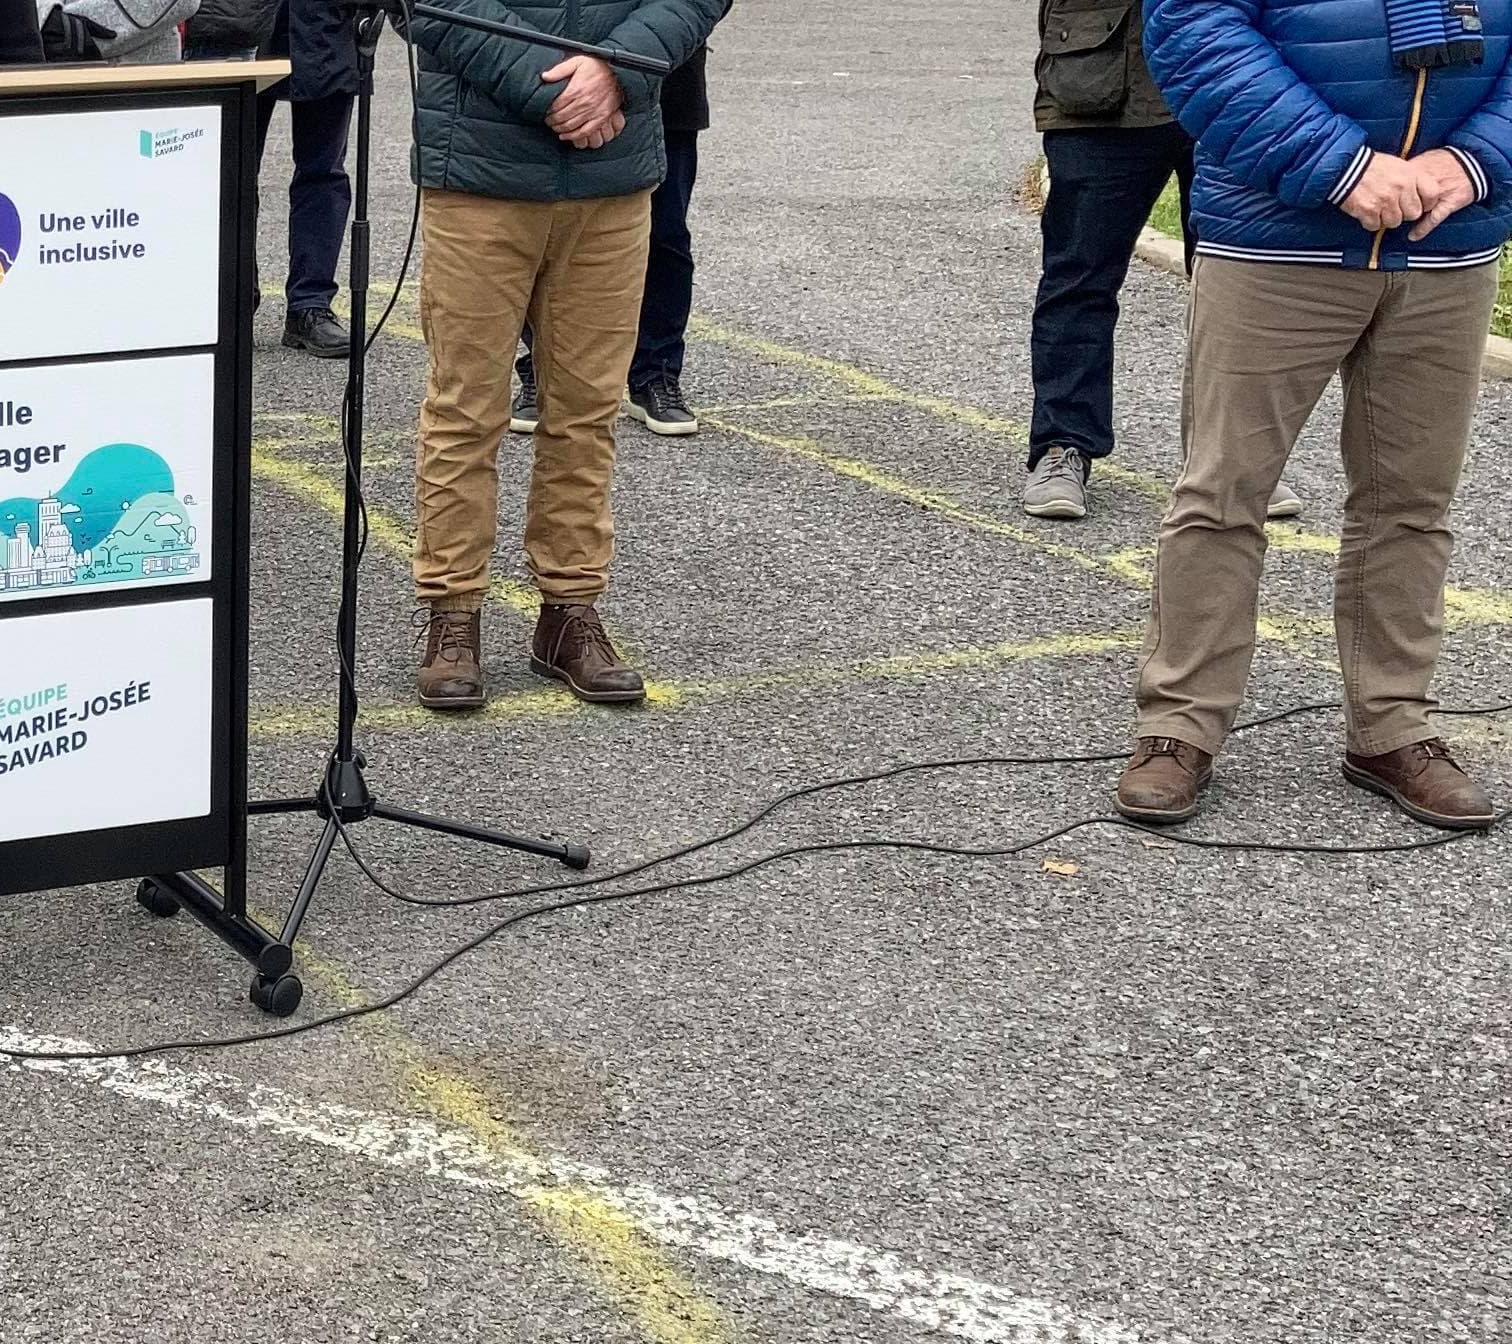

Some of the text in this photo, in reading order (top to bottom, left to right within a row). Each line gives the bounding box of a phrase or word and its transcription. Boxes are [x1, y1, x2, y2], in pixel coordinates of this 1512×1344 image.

[154, 143, 185, 157] SAVARD
[39, 208, 139, 233] Une ville
[39, 239, 145, 264] inclusive
